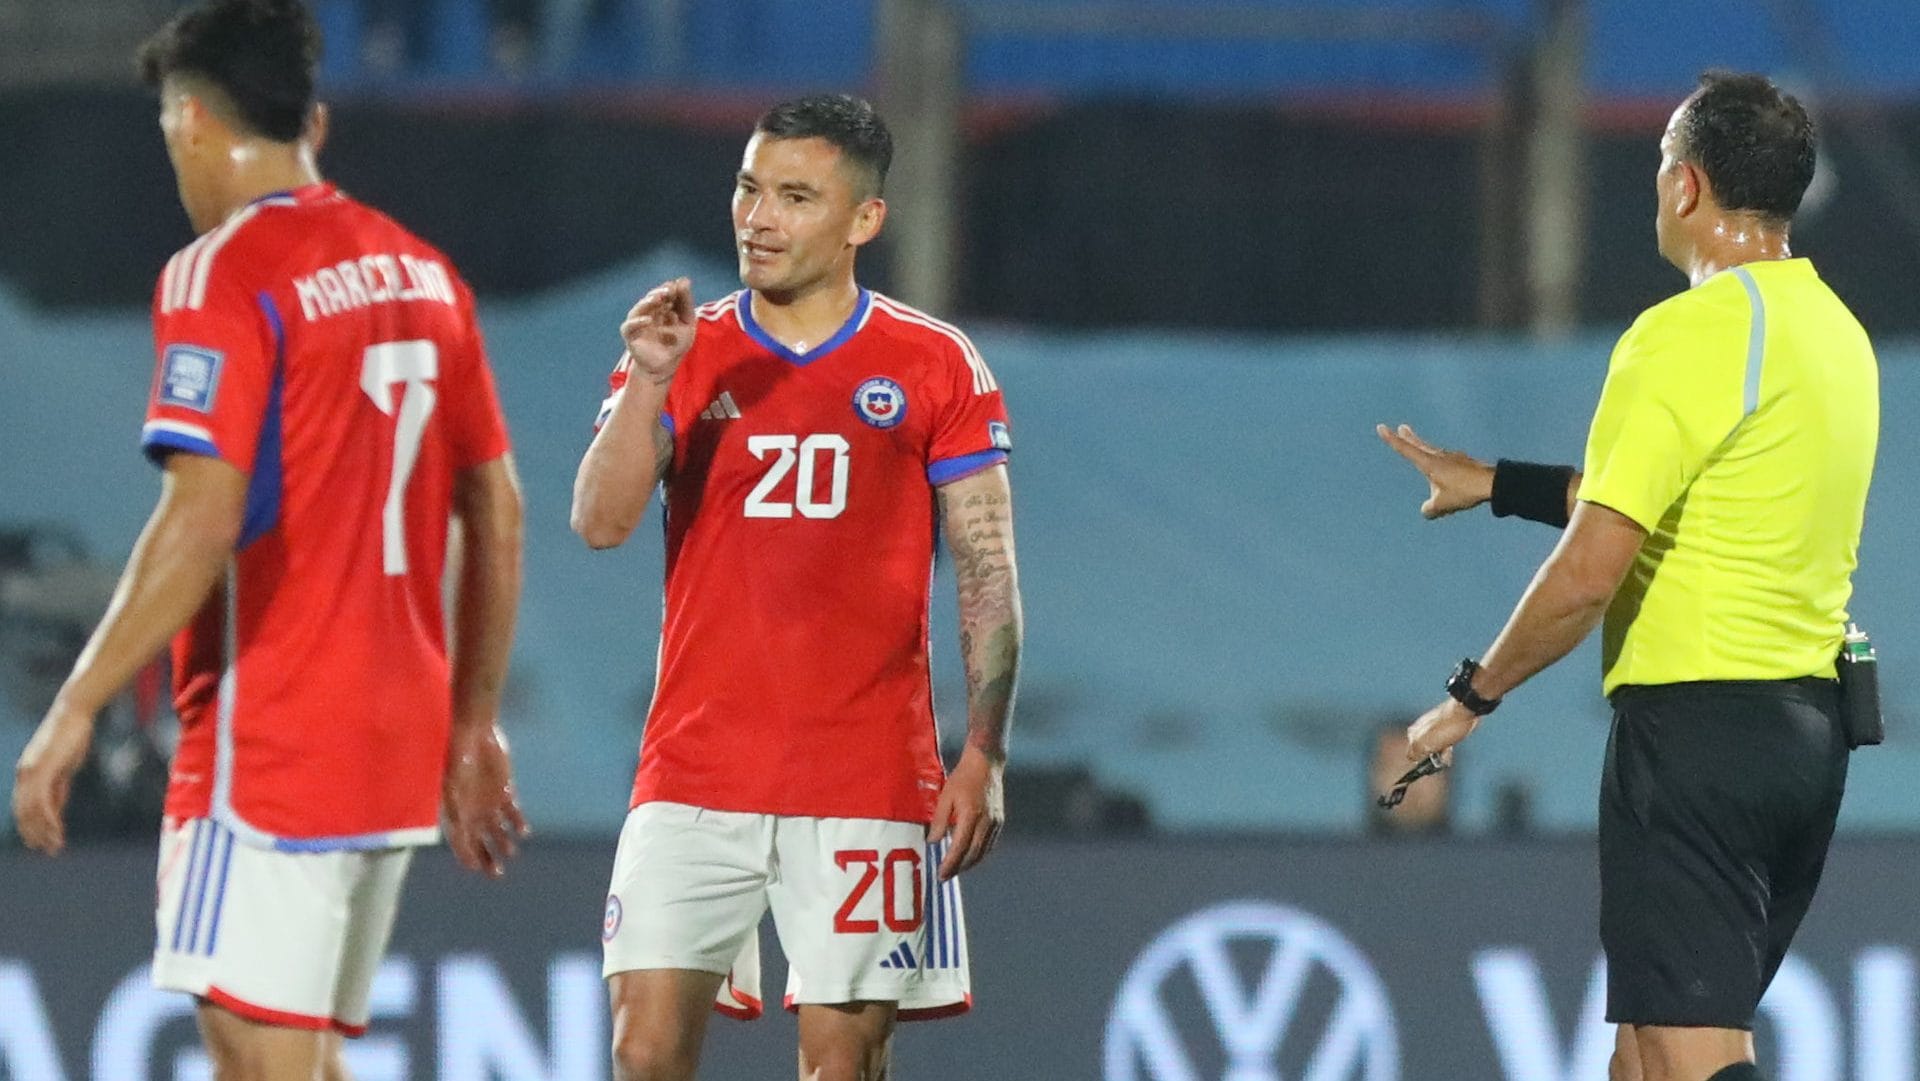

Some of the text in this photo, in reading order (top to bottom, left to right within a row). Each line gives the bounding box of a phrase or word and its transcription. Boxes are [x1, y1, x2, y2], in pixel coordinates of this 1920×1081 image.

[359, 338, 439, 576] 7
[743, 433, 851, 519] 20
[833, 848, 924, 933] 20
